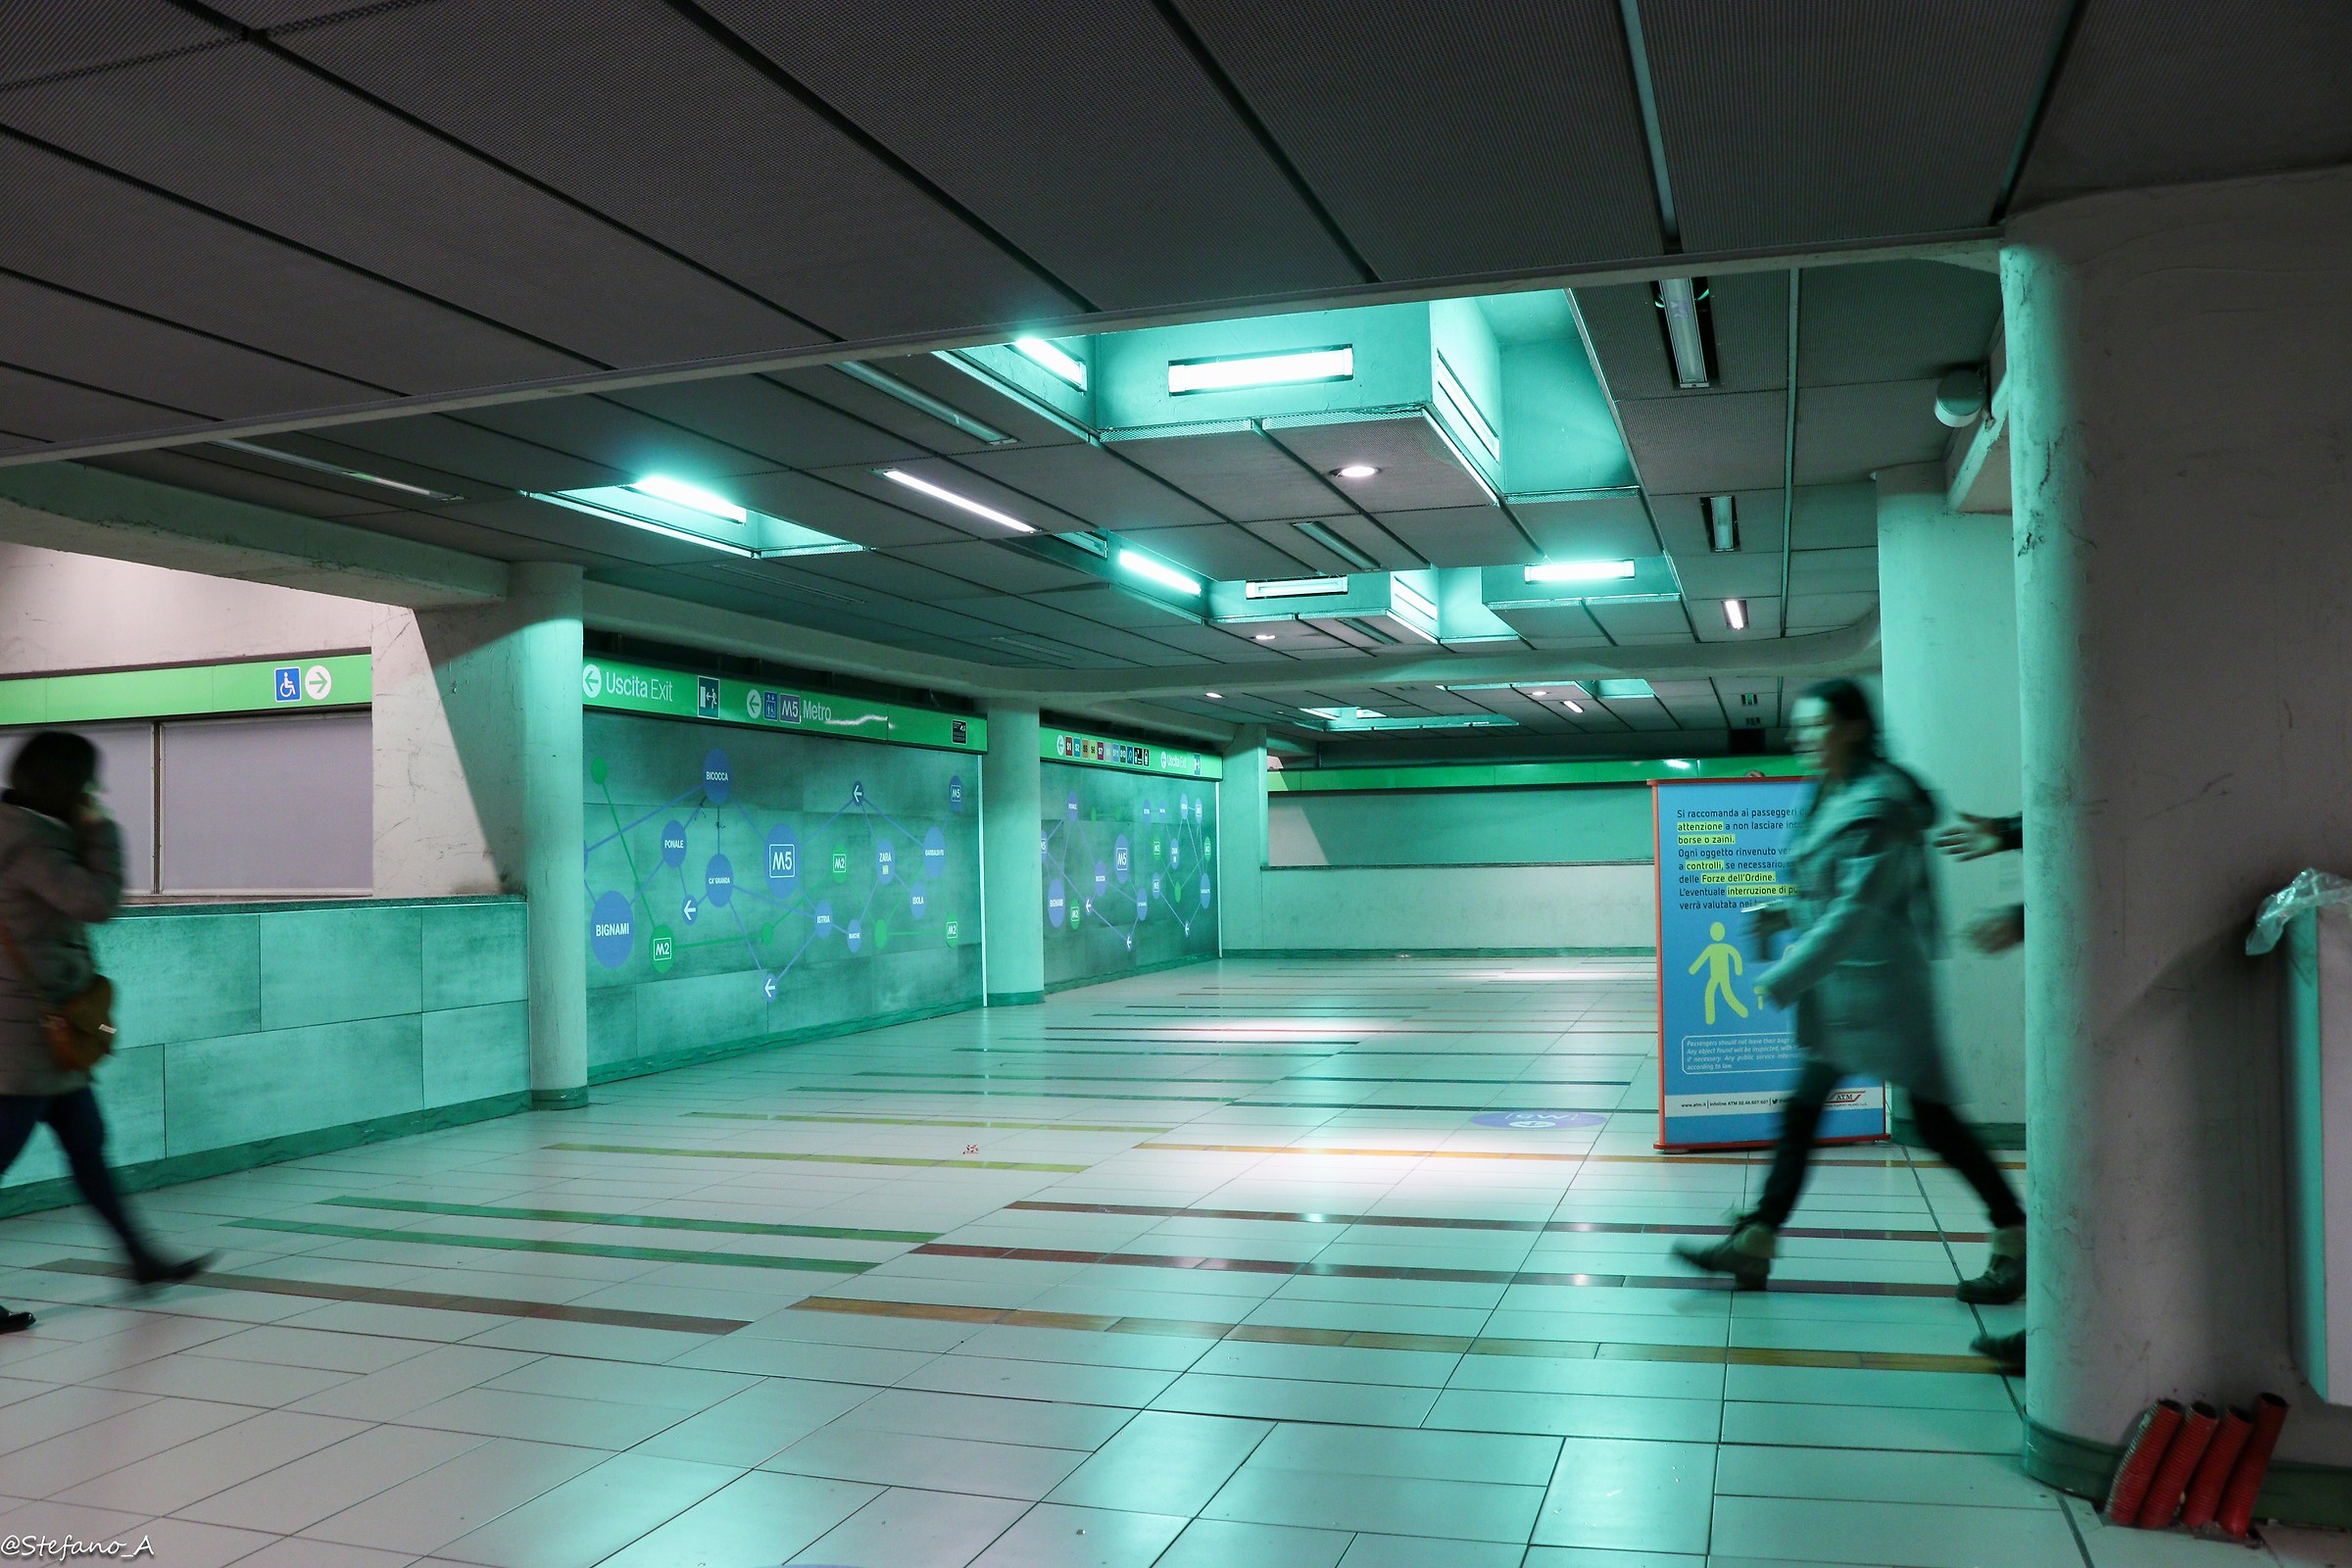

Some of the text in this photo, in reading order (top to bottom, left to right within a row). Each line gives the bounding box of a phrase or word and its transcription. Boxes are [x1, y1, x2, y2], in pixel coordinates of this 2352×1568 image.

[606, 671, 673, 703] Uscita Exit
[781, 699, 832, 721] M5 Metro
[706, 770, 729, 781] BICOCCA
[952, 788, 960, 799] M5
[1677, 809, 1686, 818] Si
[1688, 808, 1740, 818] raccomanda
[1740, 808, 1749, 817] ai
[1751, 808, 1797, 818] passeggeri
[1678, 821, 1723, 831] attenzione
[1751, 821, 1784, 830] lasciare
[664, 839, 684, 849] PONALE
[1678, 836, 1702, 845] borse
[1712, 835, 1735, 844] zaini.
[878, 852, 893, 862] ZARA
[1678, 848, 1698, 859] Ogni
[1699, 848, 1734, 859] oggetto
[1736, 847, 1777, 856] rinvenuto
[771, 851, 793, 871] M5
[834, 858, 845, 869] M2
[1117, 853, 1127, 865] M5
[1686, 860, 1724, 870] controlli,
[1738, 859, 1785, 869] necessario,
[1679, 872, 1776, 883] delle Forze dell'Ordine.
[1679, 887, 1726, 897] L'eventuale
[1727, 886, 1777, 896] interruzione
[1779, 885, 1787, 894] di
[911, 896, 924, 906] ISOLA
[1679, 900, 1701, 910] verrà
[1702, 900, 1738, 909] valutata
[1739, 900, 1752, 908] nei
[816, 914, 831, 924] ISTRIA
[595, 922, 630, 937] BIGNAMI
[948, 924, 956, 936] M2
[656, 942, 670, 956] M2
